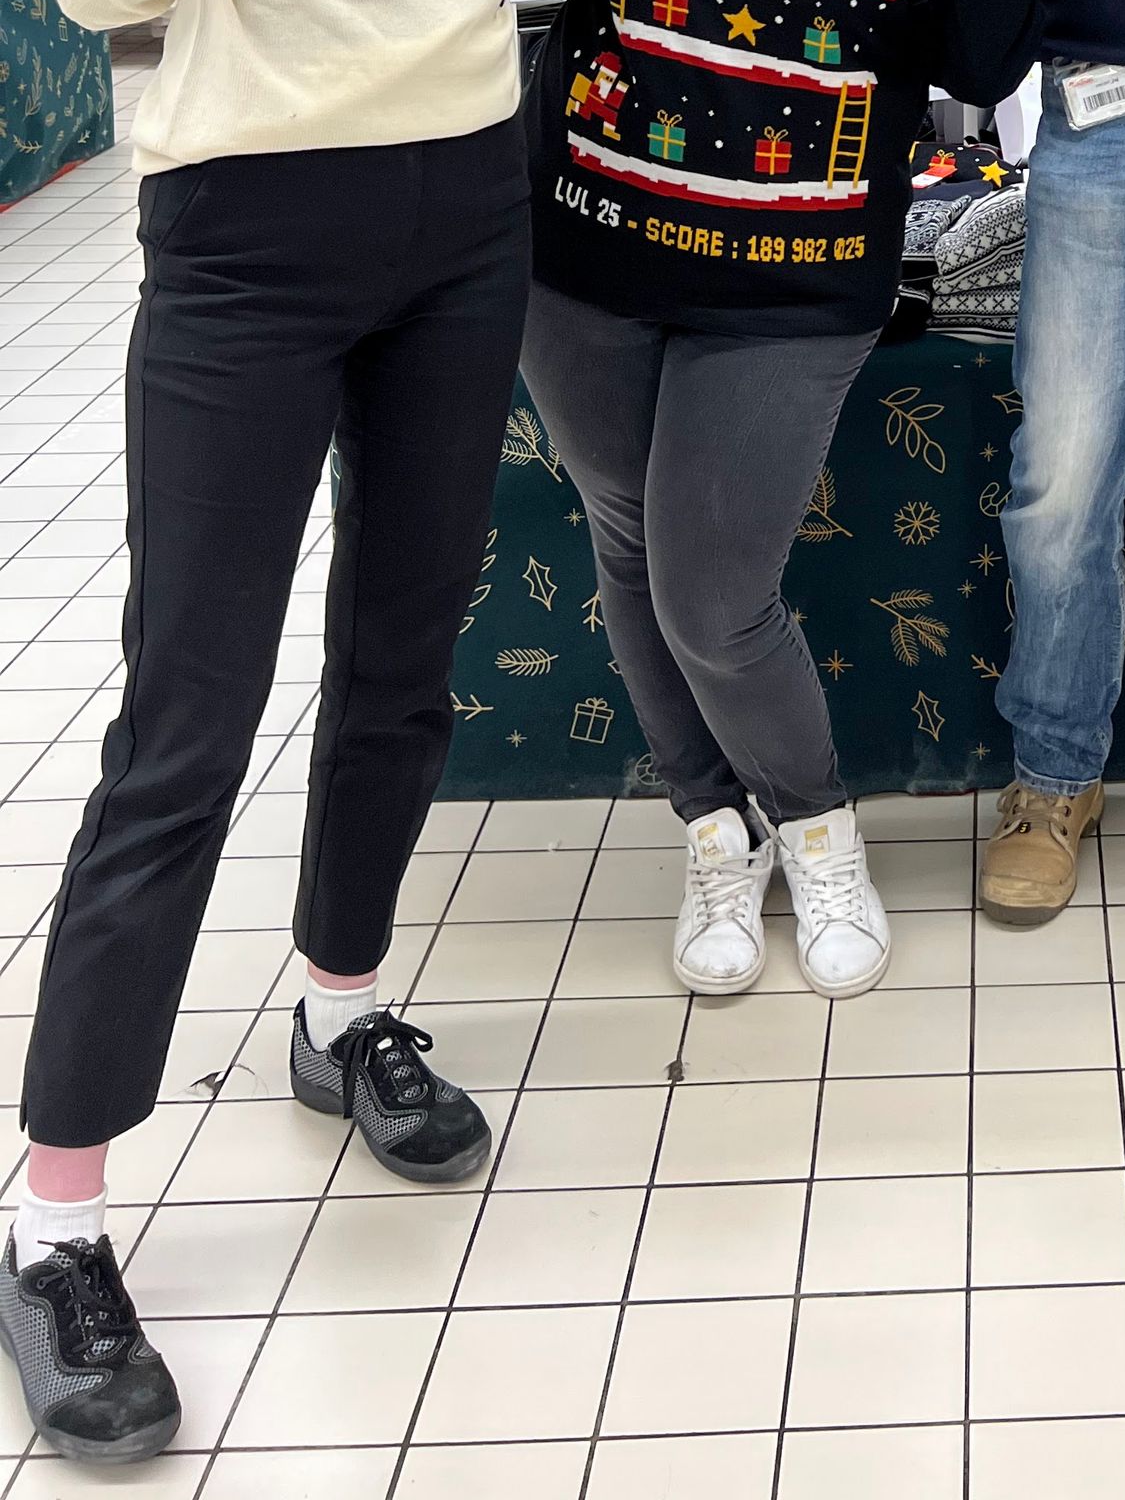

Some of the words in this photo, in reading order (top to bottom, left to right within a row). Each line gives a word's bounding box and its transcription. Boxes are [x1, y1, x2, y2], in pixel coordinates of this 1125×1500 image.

[554, 176, 590, 216] LVL
[597, 198, 622, 228] 25
[645, 217, 724, 257] SCORE
[747, 235, 785, 263] 189
[791, 237, 828, 263] 982
[834, 234, 866, 261] 025
